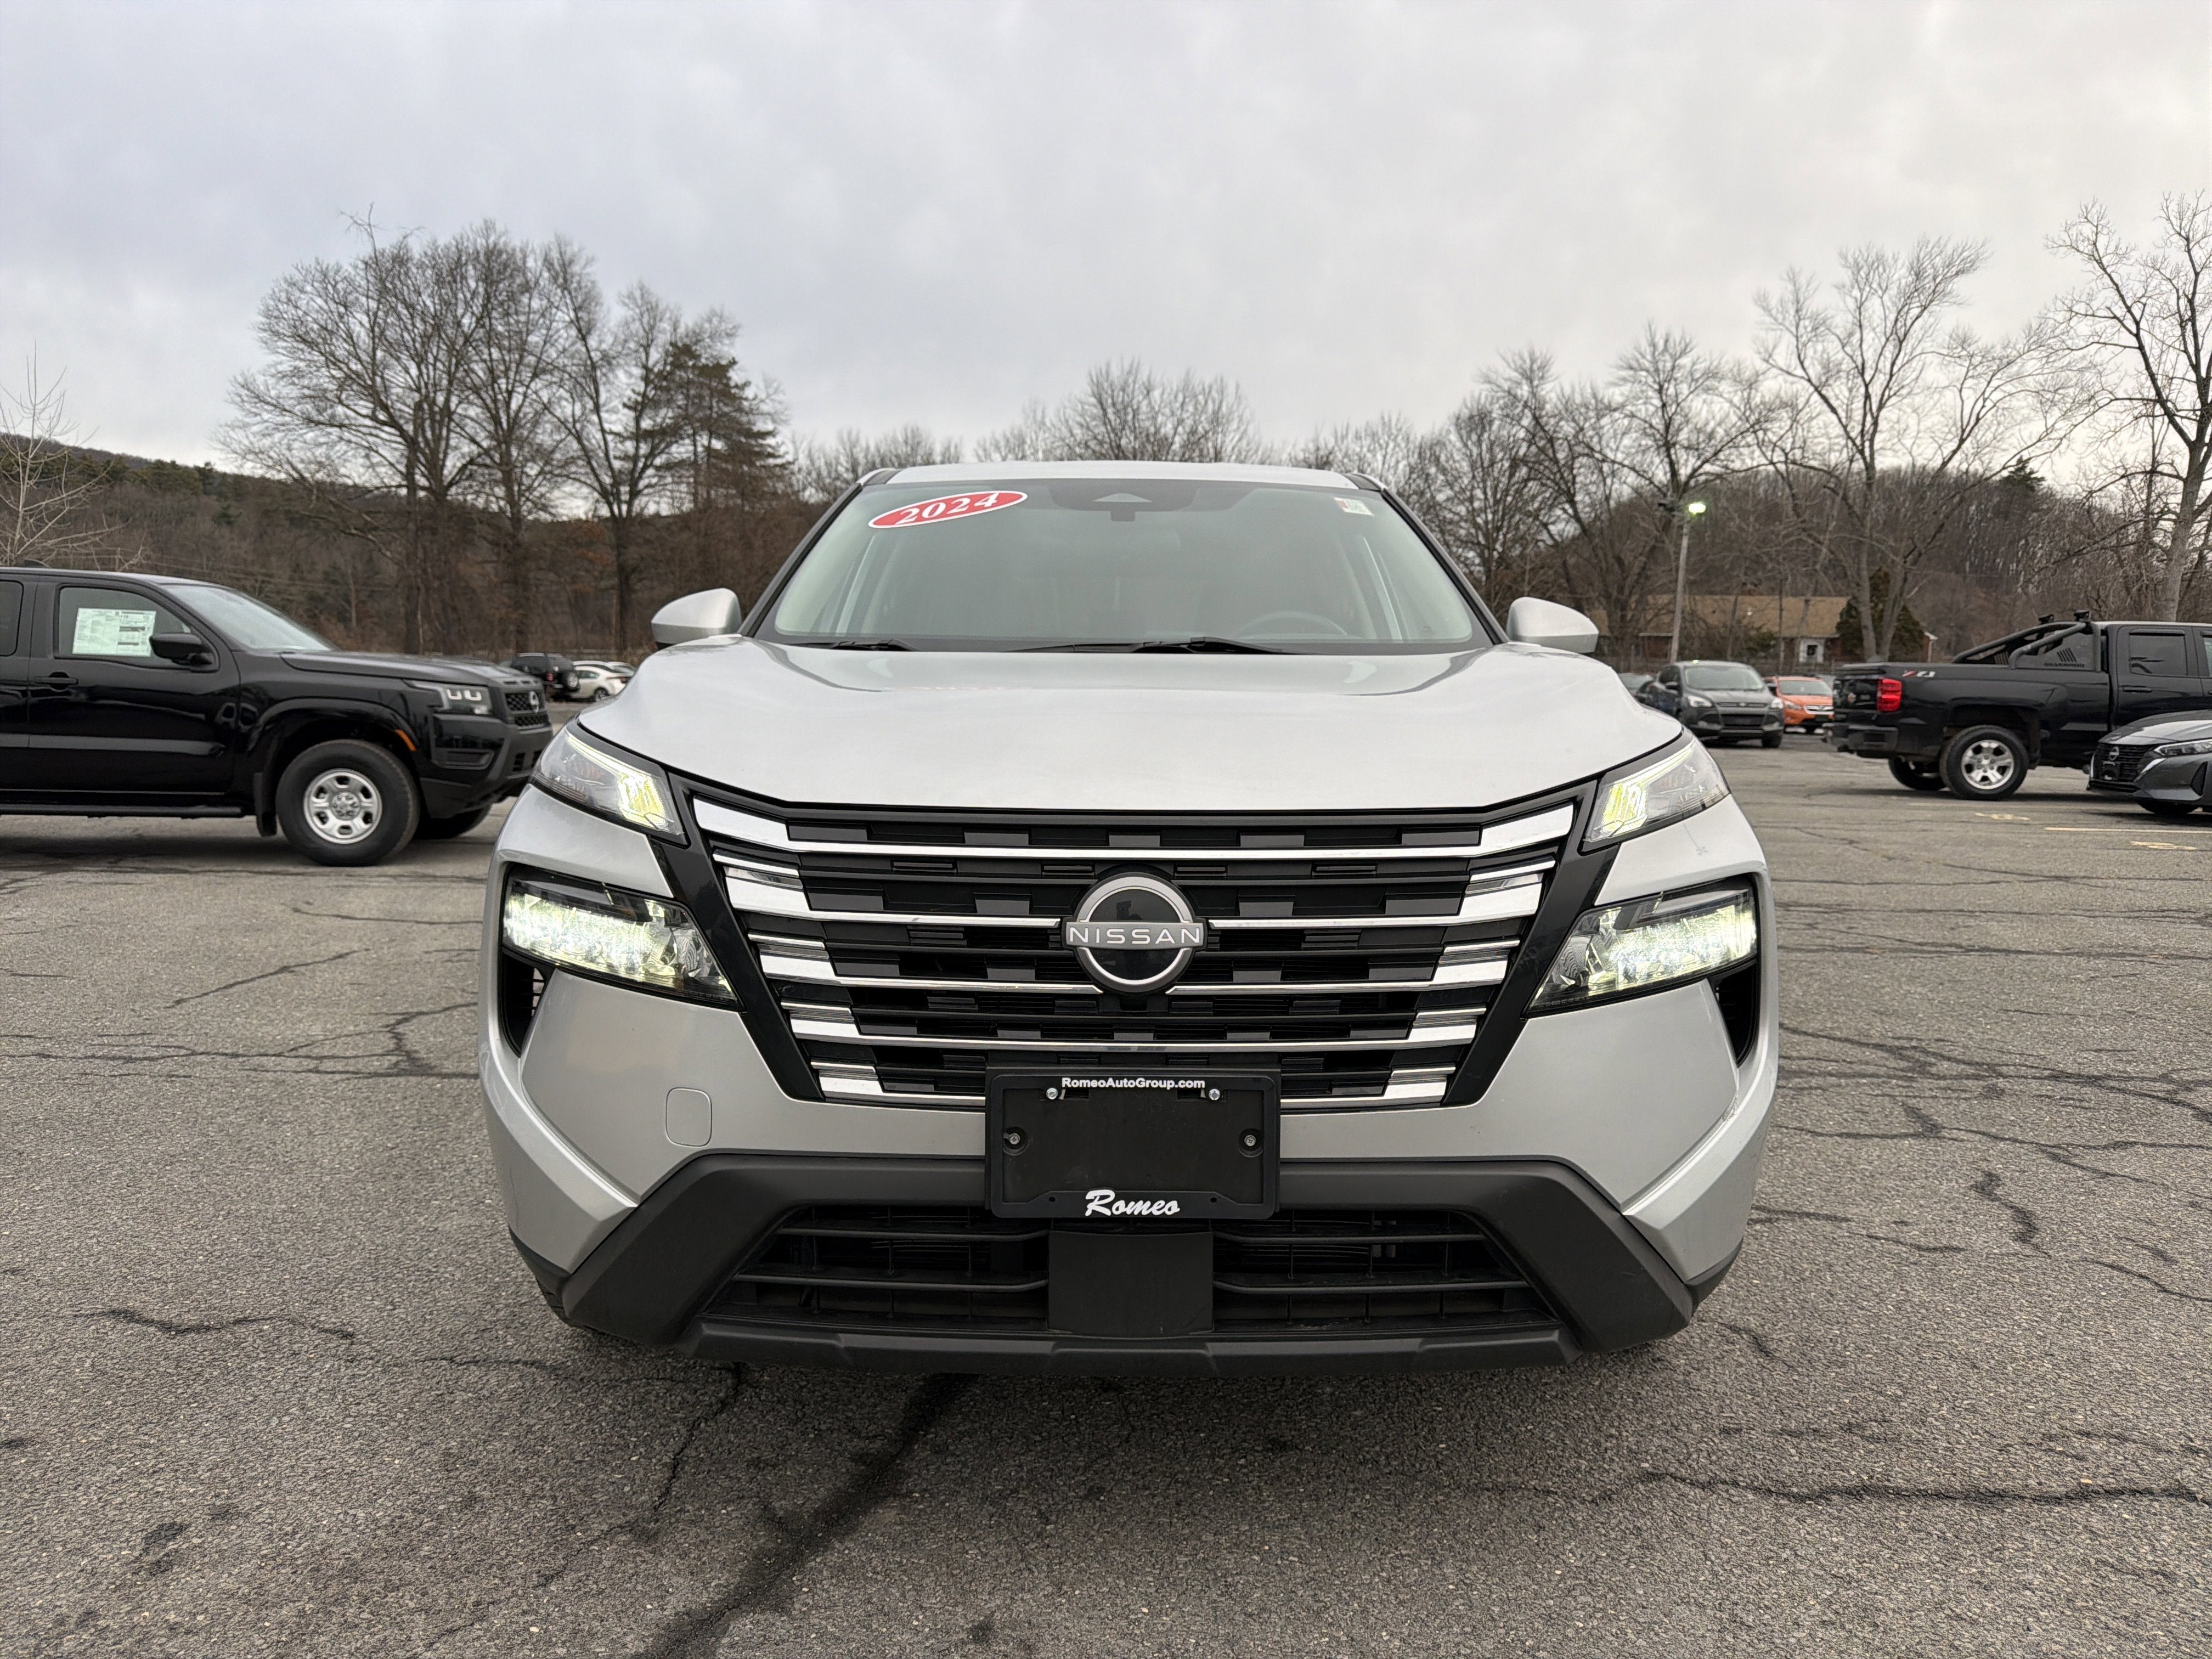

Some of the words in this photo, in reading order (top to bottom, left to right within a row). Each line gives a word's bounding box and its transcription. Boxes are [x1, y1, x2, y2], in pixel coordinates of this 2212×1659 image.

[895, 493, 999, 525] 2024
[1070, 927, 1200, 944] NISSAN
[1061, 1077, 1206, 1090] RomeoAutoGroup.com
[1084, 1189, 1181, 1217] Romeo
